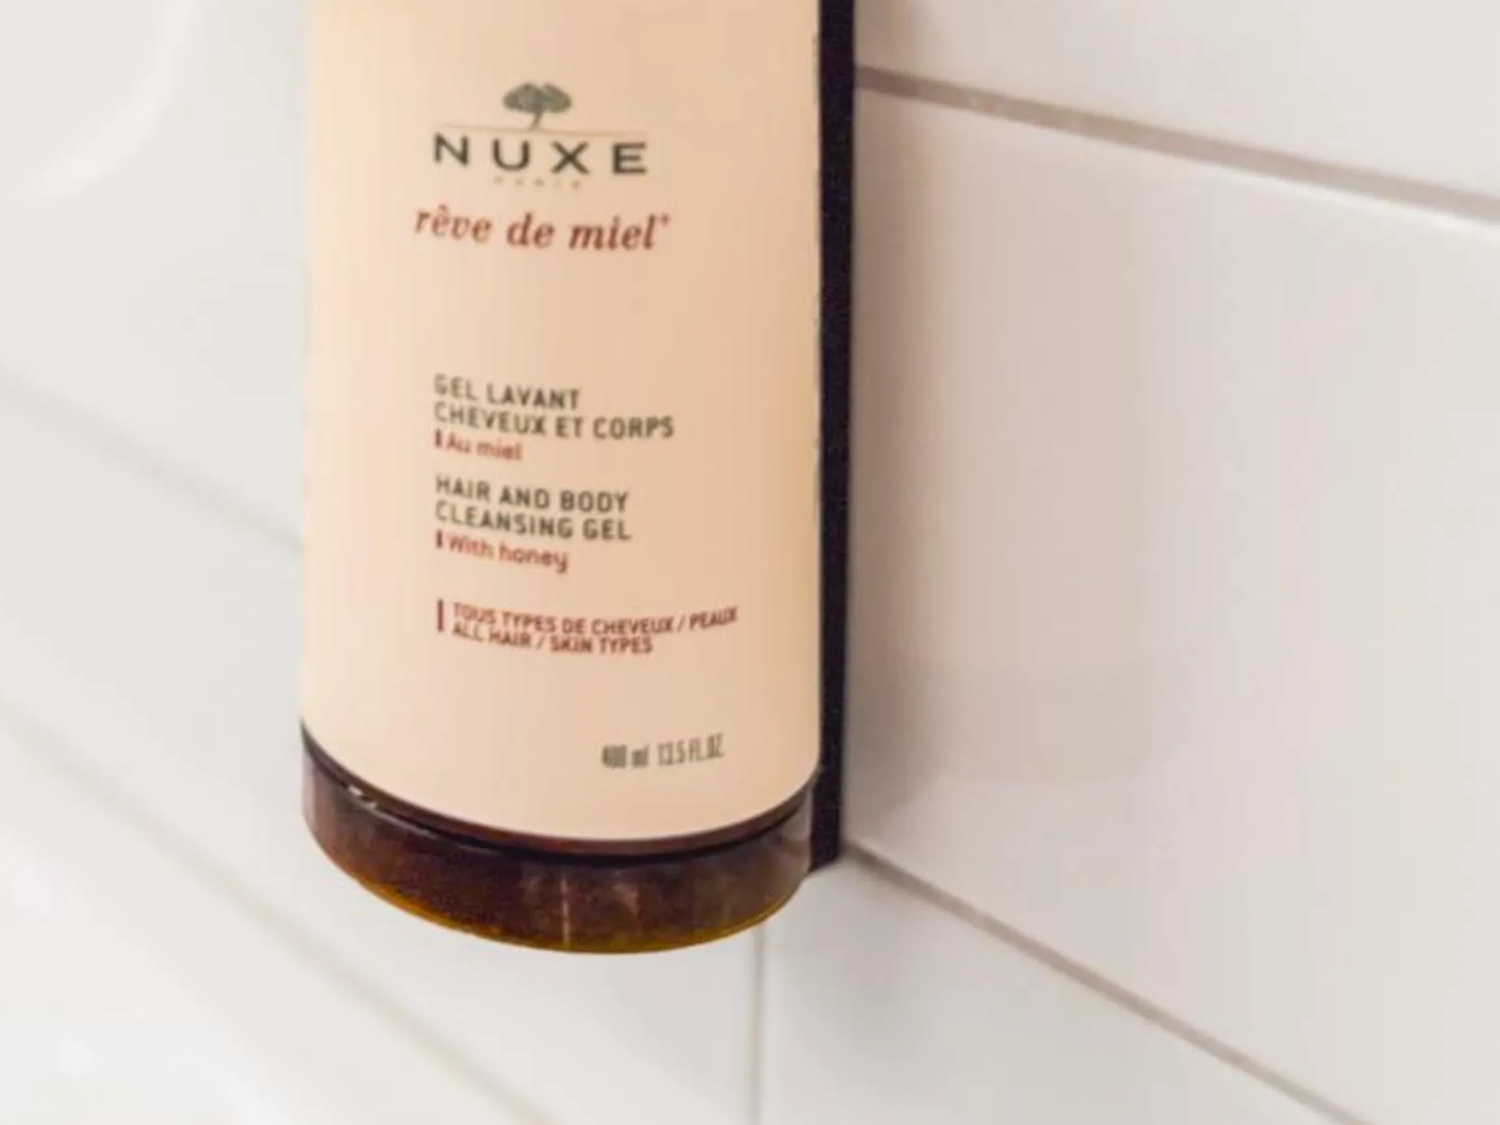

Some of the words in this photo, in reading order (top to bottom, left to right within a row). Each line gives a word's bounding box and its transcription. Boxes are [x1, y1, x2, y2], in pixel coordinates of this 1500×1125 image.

[434, 132, 648, 175] NUXE
[414, 203, 492, 243] rêve
[506, 211, 555, 248] de
[434, 374, 479, 401] GEL
[486, 383, 580, 410] LAVANT
[434, 401, 547, 436] CHEVEUX
[555, 416, 583, 438] ET
[592, 415, 675, 439] CORPS
[446, 432, 472, 454] Au
[476, 439, 523, 461] miel
[435, 475, 491, 502] HAIR
[499, 485, 550, 510] AND
[560, 490, 630, 513] BODY
[435, 500, 574, 540] CLEANSING
[582, 518, 632, 541] GEL
[449, 534, 494, 560] With
[499, 542, 569, 574] honey
[453, 602, 496, 625] TOUS
[501, 611, 557, 634] TYPES
[562, 617, 587, 635] DE
[591, 616, 675, 636] CHEVEUX
[688, 606, 739, 630] PEAUX
[451, 622, 483, 643] ALL
[488, 629, 532, 649] HAIR
[551, 634, 594, 653] SKIN
[600, 635, 654, 655] TYPES
